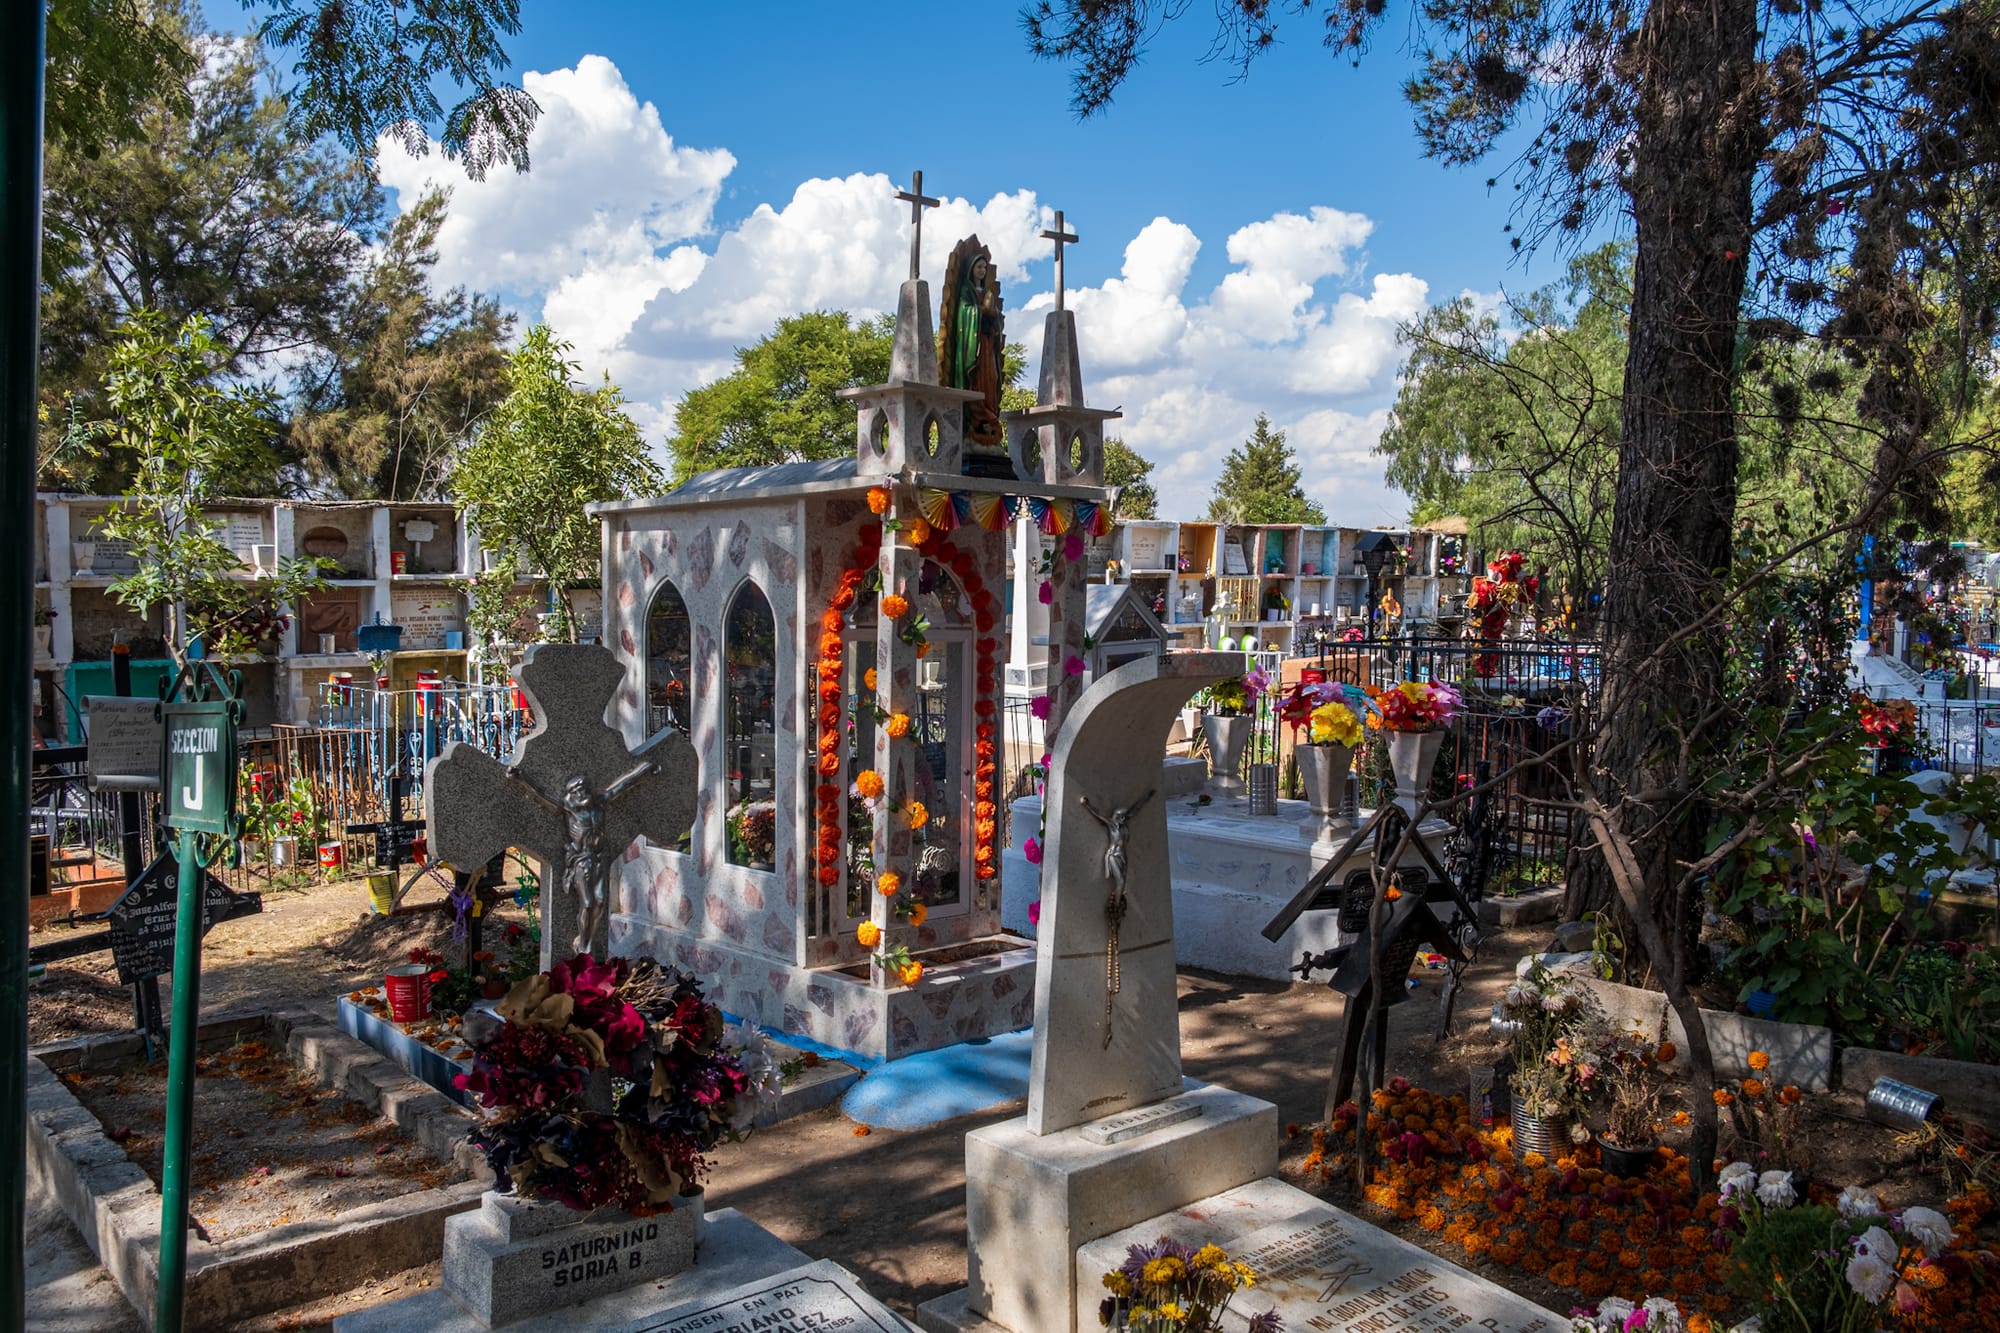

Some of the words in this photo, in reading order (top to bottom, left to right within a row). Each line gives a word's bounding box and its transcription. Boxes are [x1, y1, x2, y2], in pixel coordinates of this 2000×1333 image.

[171, 727, 218, 753] SECCION
[183, 754, 204, 811] J
[541, 1223, 658, 1270] SATURNINO
[554, 1255, 618, 1287] SORIA
[629, 1251, 649, 1270] B.
[657, 1312, 725, 1333] ANSEN
[742, 1298, 767, 1312] EN
[773, 1286, 804, 1300] PAZ
[1326, 1286, 1399, 1322] GUADALUPE
[1387, 1303, 1416, 1319] DE
[1403, 1286, 1449, 1311] REYES
[760, 1311, 830, 1333] ALEZ
